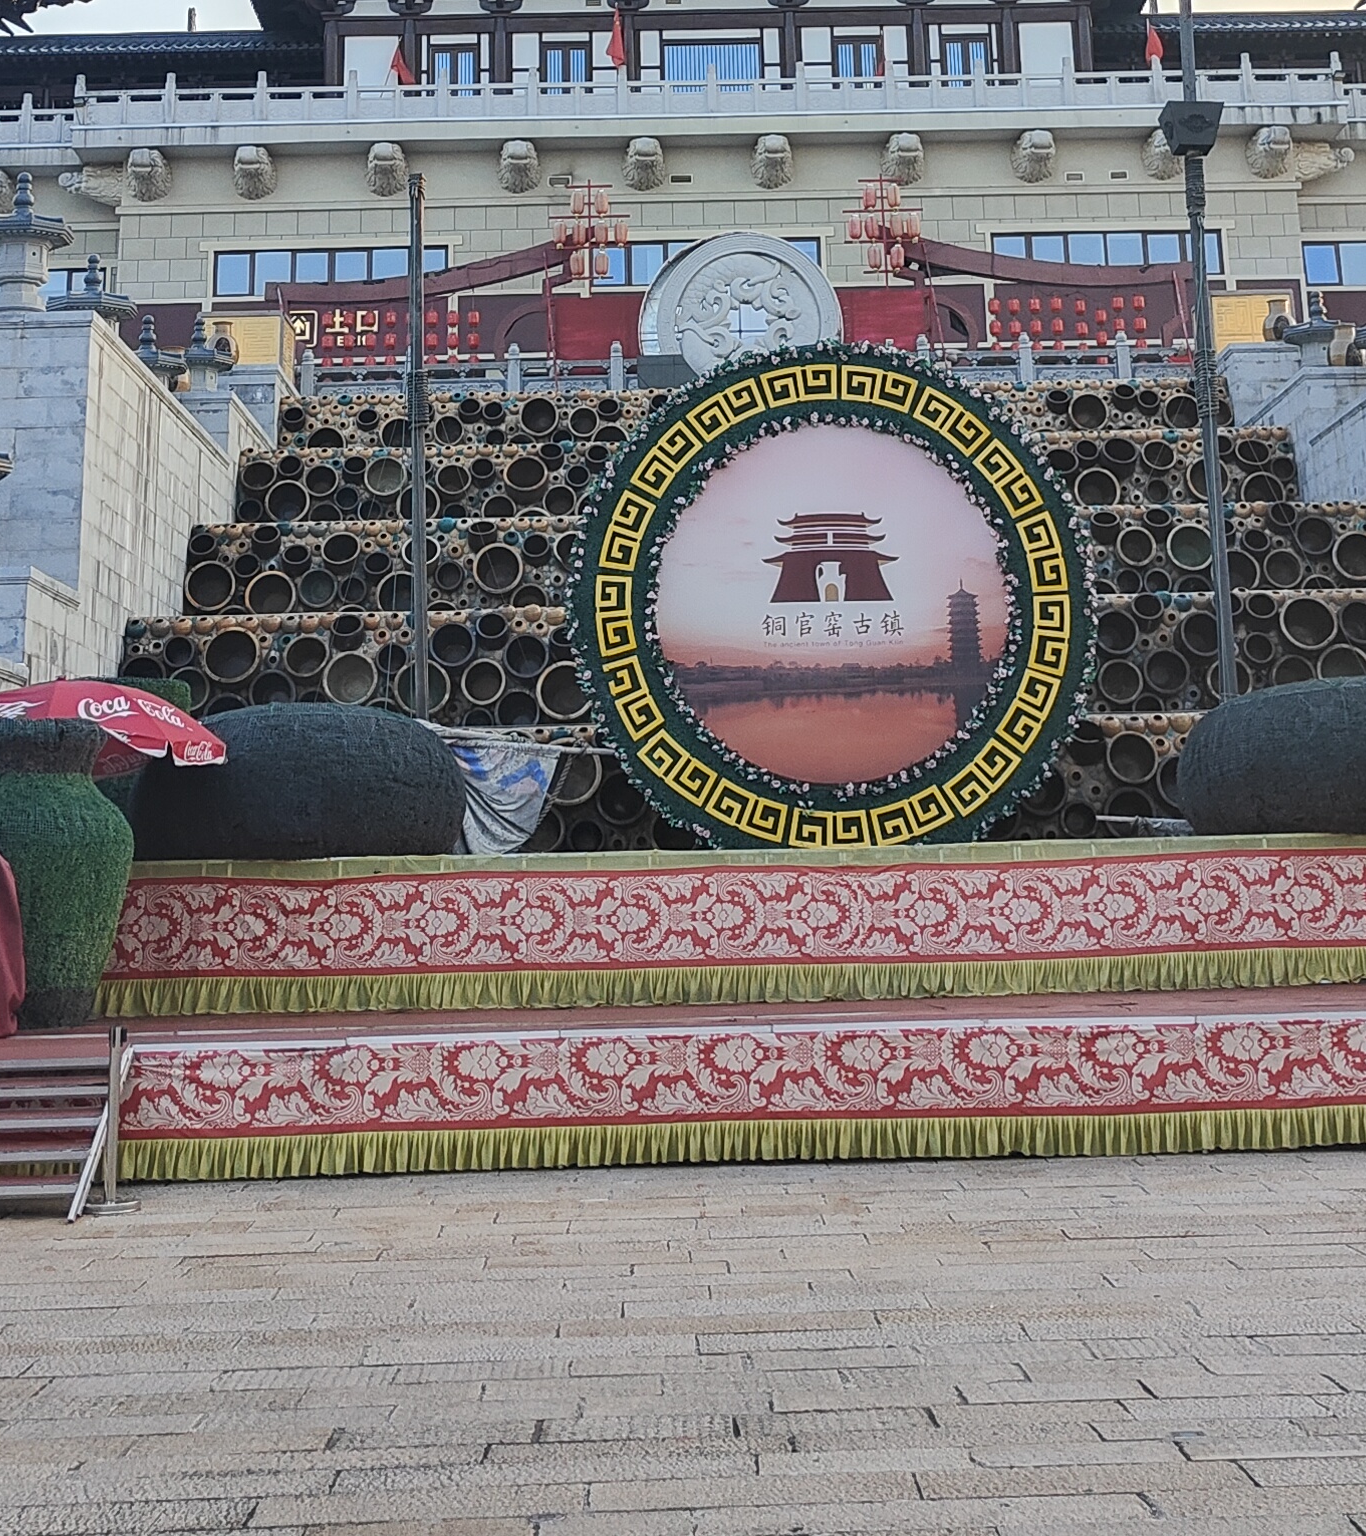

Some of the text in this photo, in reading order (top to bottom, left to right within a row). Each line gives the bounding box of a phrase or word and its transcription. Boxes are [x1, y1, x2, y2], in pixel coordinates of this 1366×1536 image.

[761, 610, 905, 637] 铜官窑古镇
